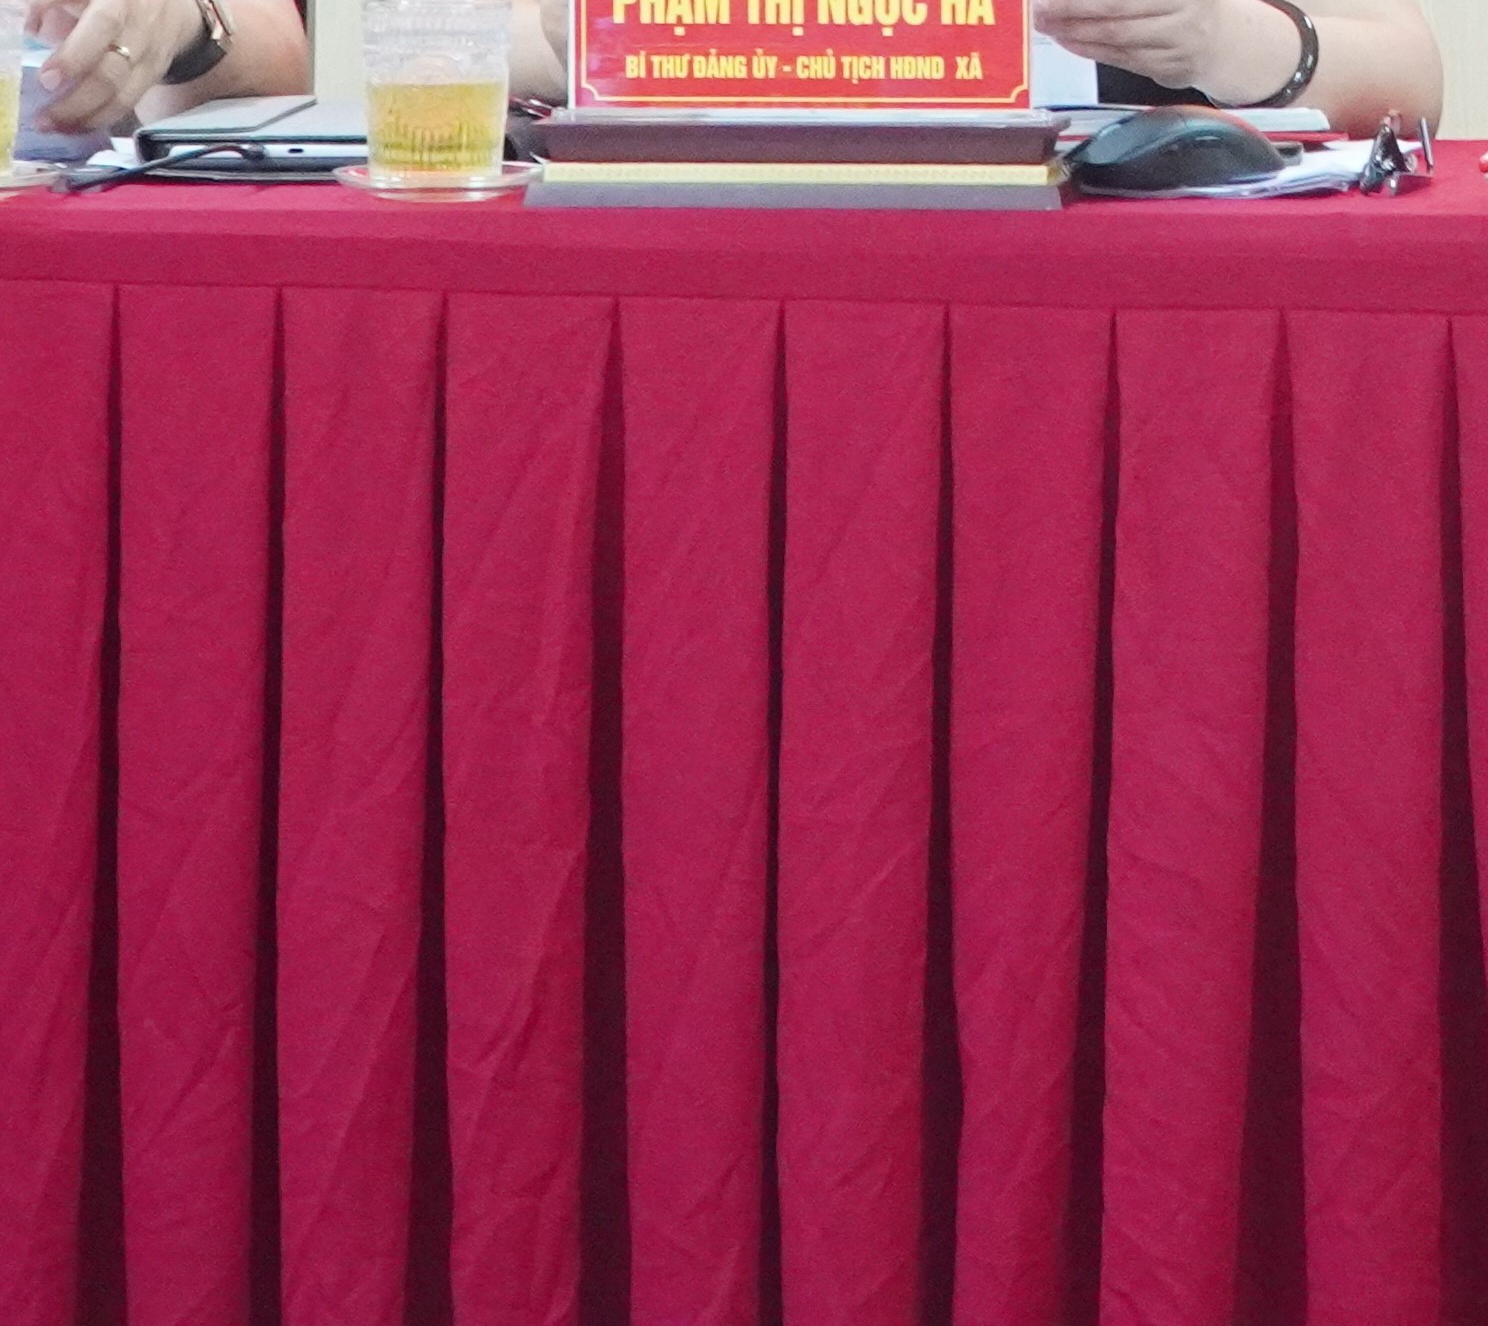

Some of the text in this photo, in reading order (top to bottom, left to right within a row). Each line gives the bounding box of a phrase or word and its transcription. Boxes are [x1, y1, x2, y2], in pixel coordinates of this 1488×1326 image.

[625, 50, 647, 79] BÍ
[650, 53, 691, 79] THƯ
[692, 48, 748, 79] ĐẢNG
[751, 48, 779, 79] ỦY
[795, 50, 837, 80] CHỦ
[840, 55, 886, 84] TỊCH
[889, 55, 945, 80] HĐND
[955, 52, 983, 80] XÃ
